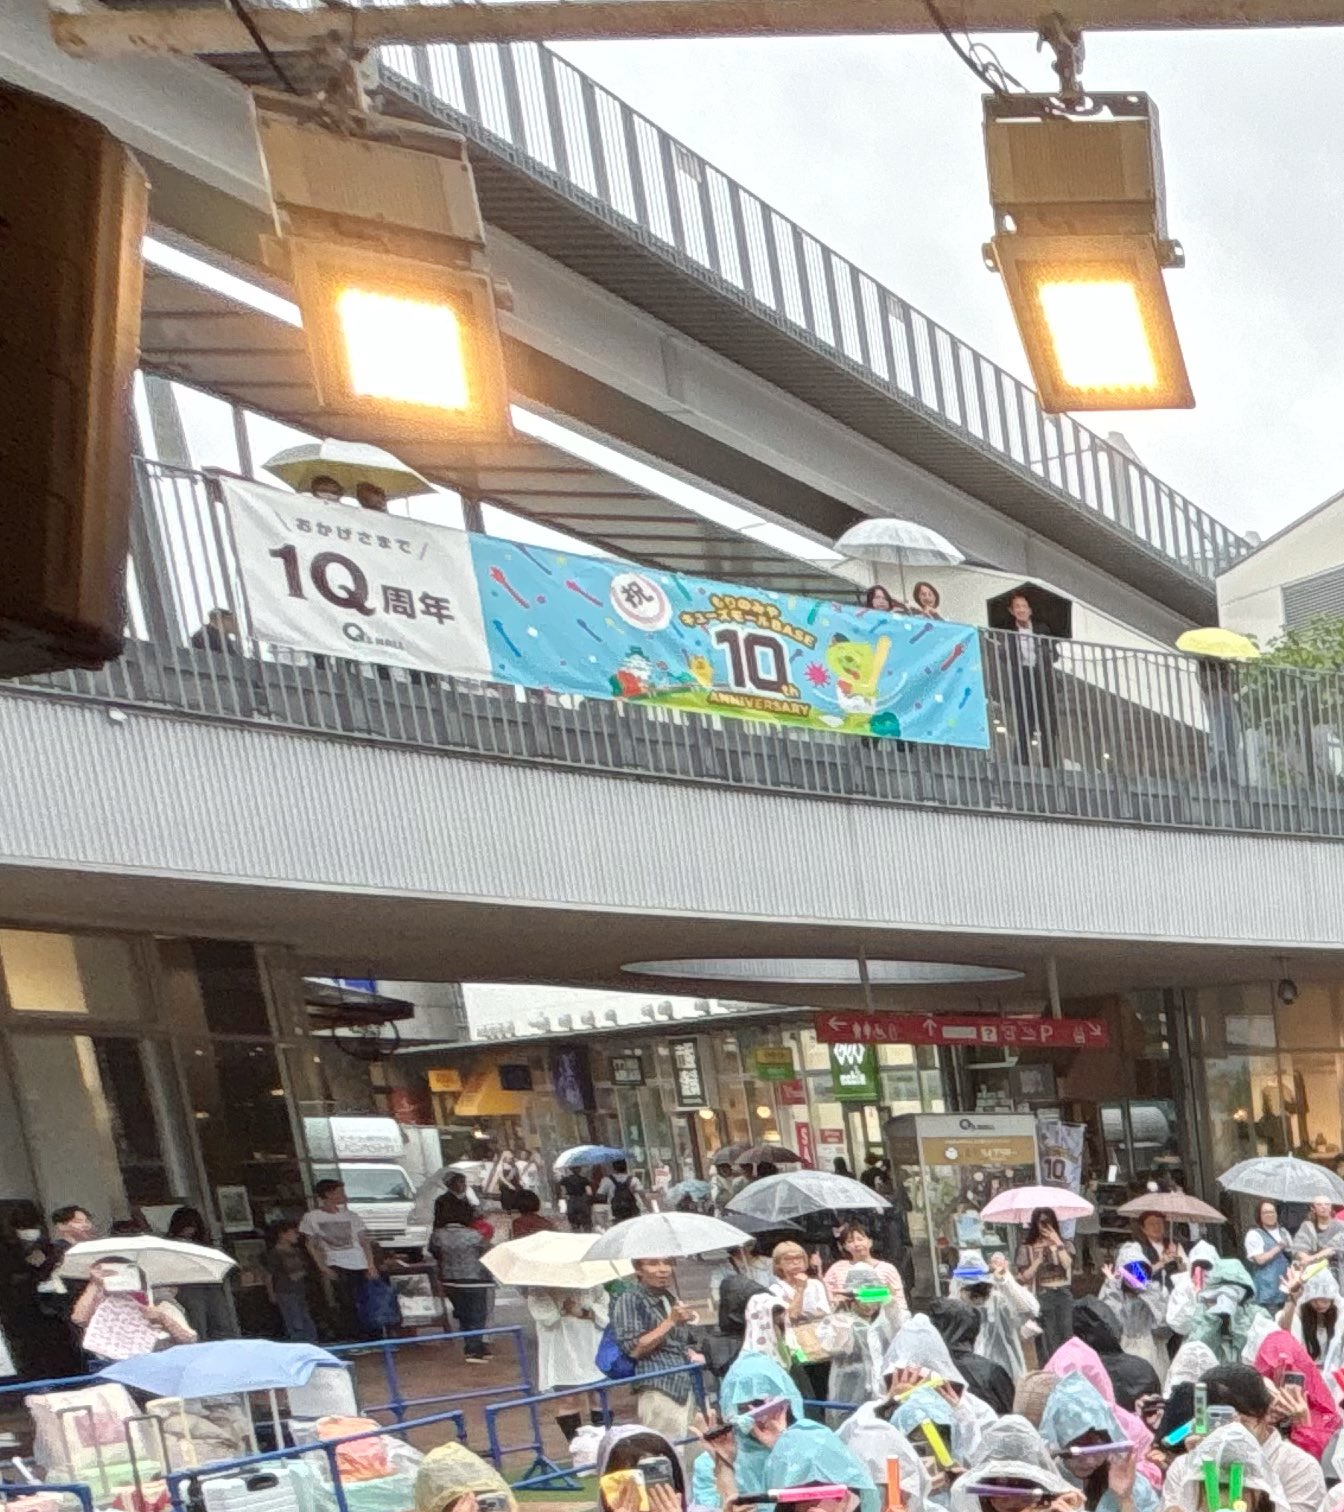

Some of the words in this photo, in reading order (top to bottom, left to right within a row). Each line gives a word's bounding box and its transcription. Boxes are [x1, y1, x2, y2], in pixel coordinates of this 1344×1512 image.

[296, 517, 411, 555] おかげさまで
[621, 581, 654, 609] 祝
[707, 691, 811, 717] ANNIVERSARY
